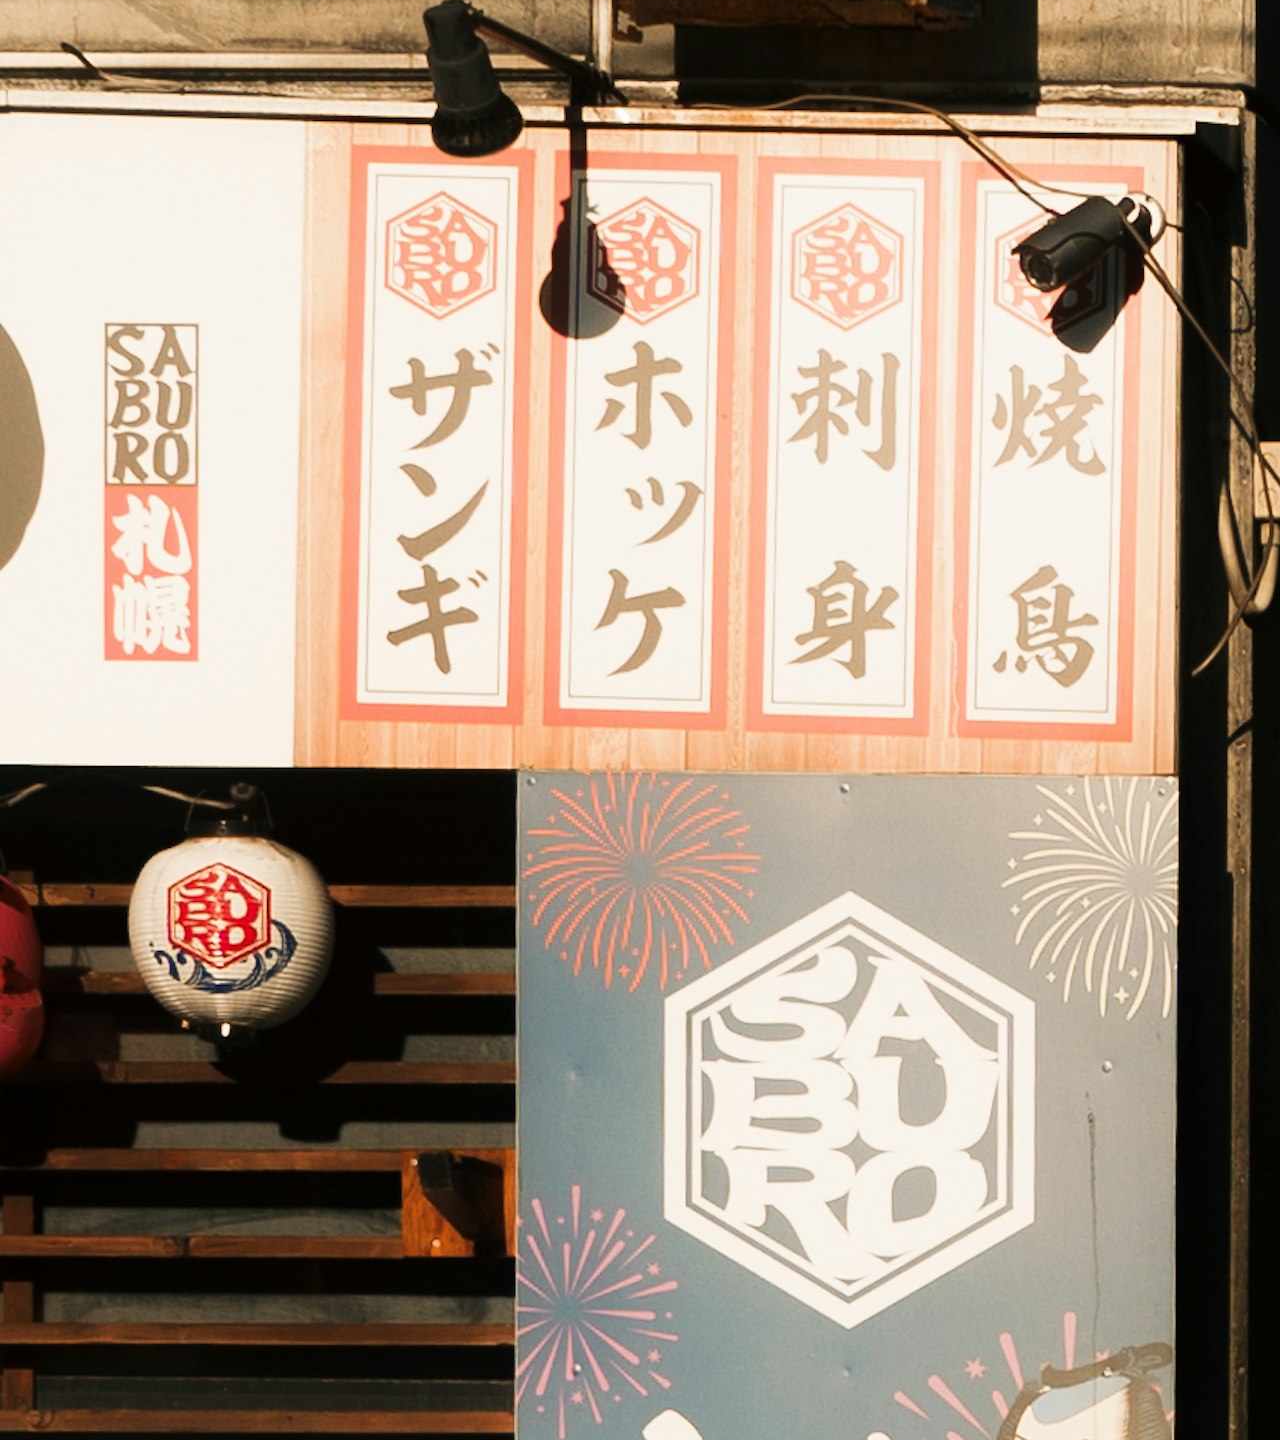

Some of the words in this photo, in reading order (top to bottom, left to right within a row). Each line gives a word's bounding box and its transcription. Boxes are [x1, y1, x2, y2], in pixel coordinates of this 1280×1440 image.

[109, 494, 192, 655] 札幌
[389, 342, 501, 674] ザンギ
[593, 340, 703, 676] ホッケ
[786, 347, 899, 679] 刺身
[991, 352, 1106, 687] 焼鳥
